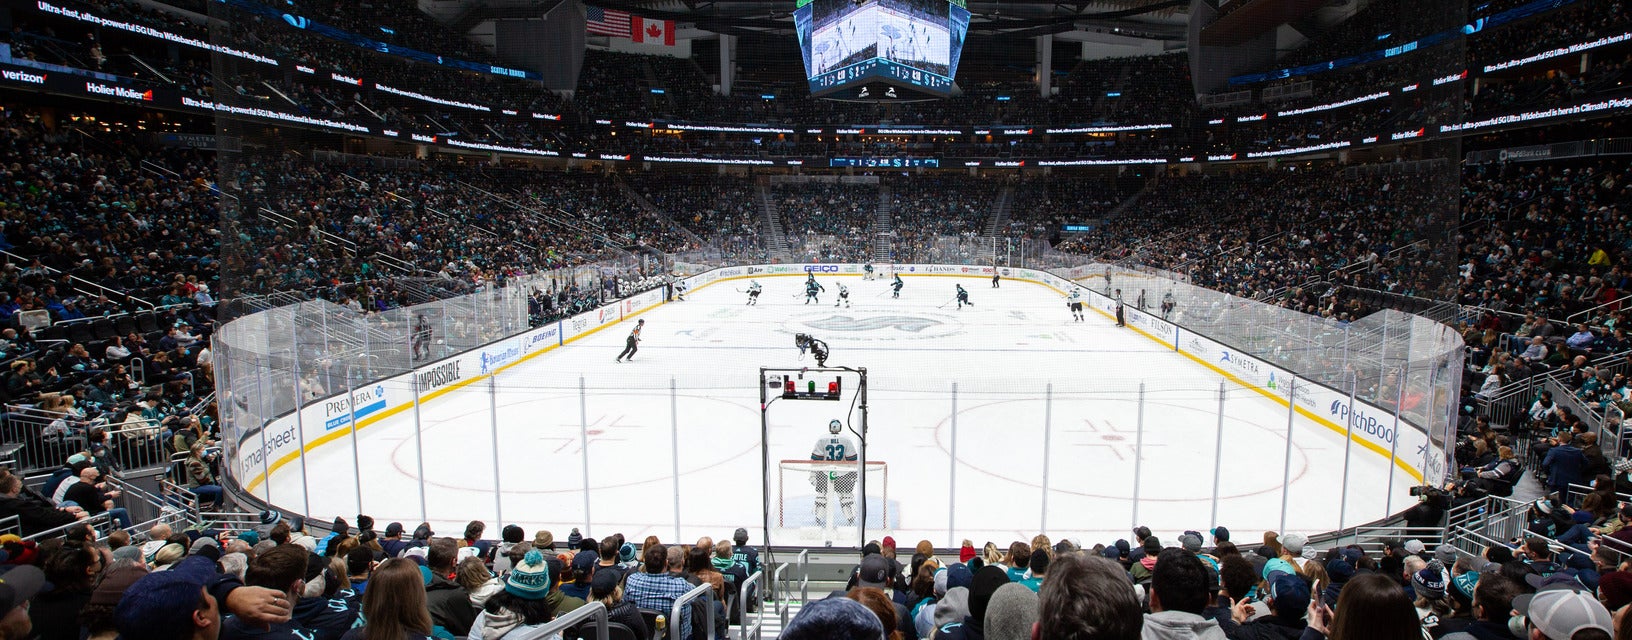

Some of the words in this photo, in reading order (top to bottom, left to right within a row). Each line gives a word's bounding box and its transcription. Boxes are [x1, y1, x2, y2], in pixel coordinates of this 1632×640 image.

[37, 1, 81, 20] Ultra-fast,
[81, 13, 136, 31] ultra-powerful
[136, 25, 147, 34] 5G
[147, 27, 164, 38] Ultra
[164, 31, 197, 46] Wideband
[2, 70, 43, 84] verizon
[86, 82, 114, 95] Holier
[115, 86, 144, 99] Molier
[182, 97, 215, 111] Ultra-fast,
[1440, 123, 1463, 133] Ultra-fast
[1520, 109, 1552, 121] Wideband
[1558, 107, 1574, 116] here
[1580, 101, 1608, 112] Climate
[532, 328, 557, 344] BOEING
[1151, 318, 1172, 336] FILSON
[1230, 354, 1259, 375] SYMETRA
[418, 361, 459, 393] IMPOSSIBLE
[1341, 404, 1400, 448] PtchBoo
[245, 425, 296, 473] smatsheet
[825, 445, 845, 461] 33
[730, 553, 748, 562] EATTLE
